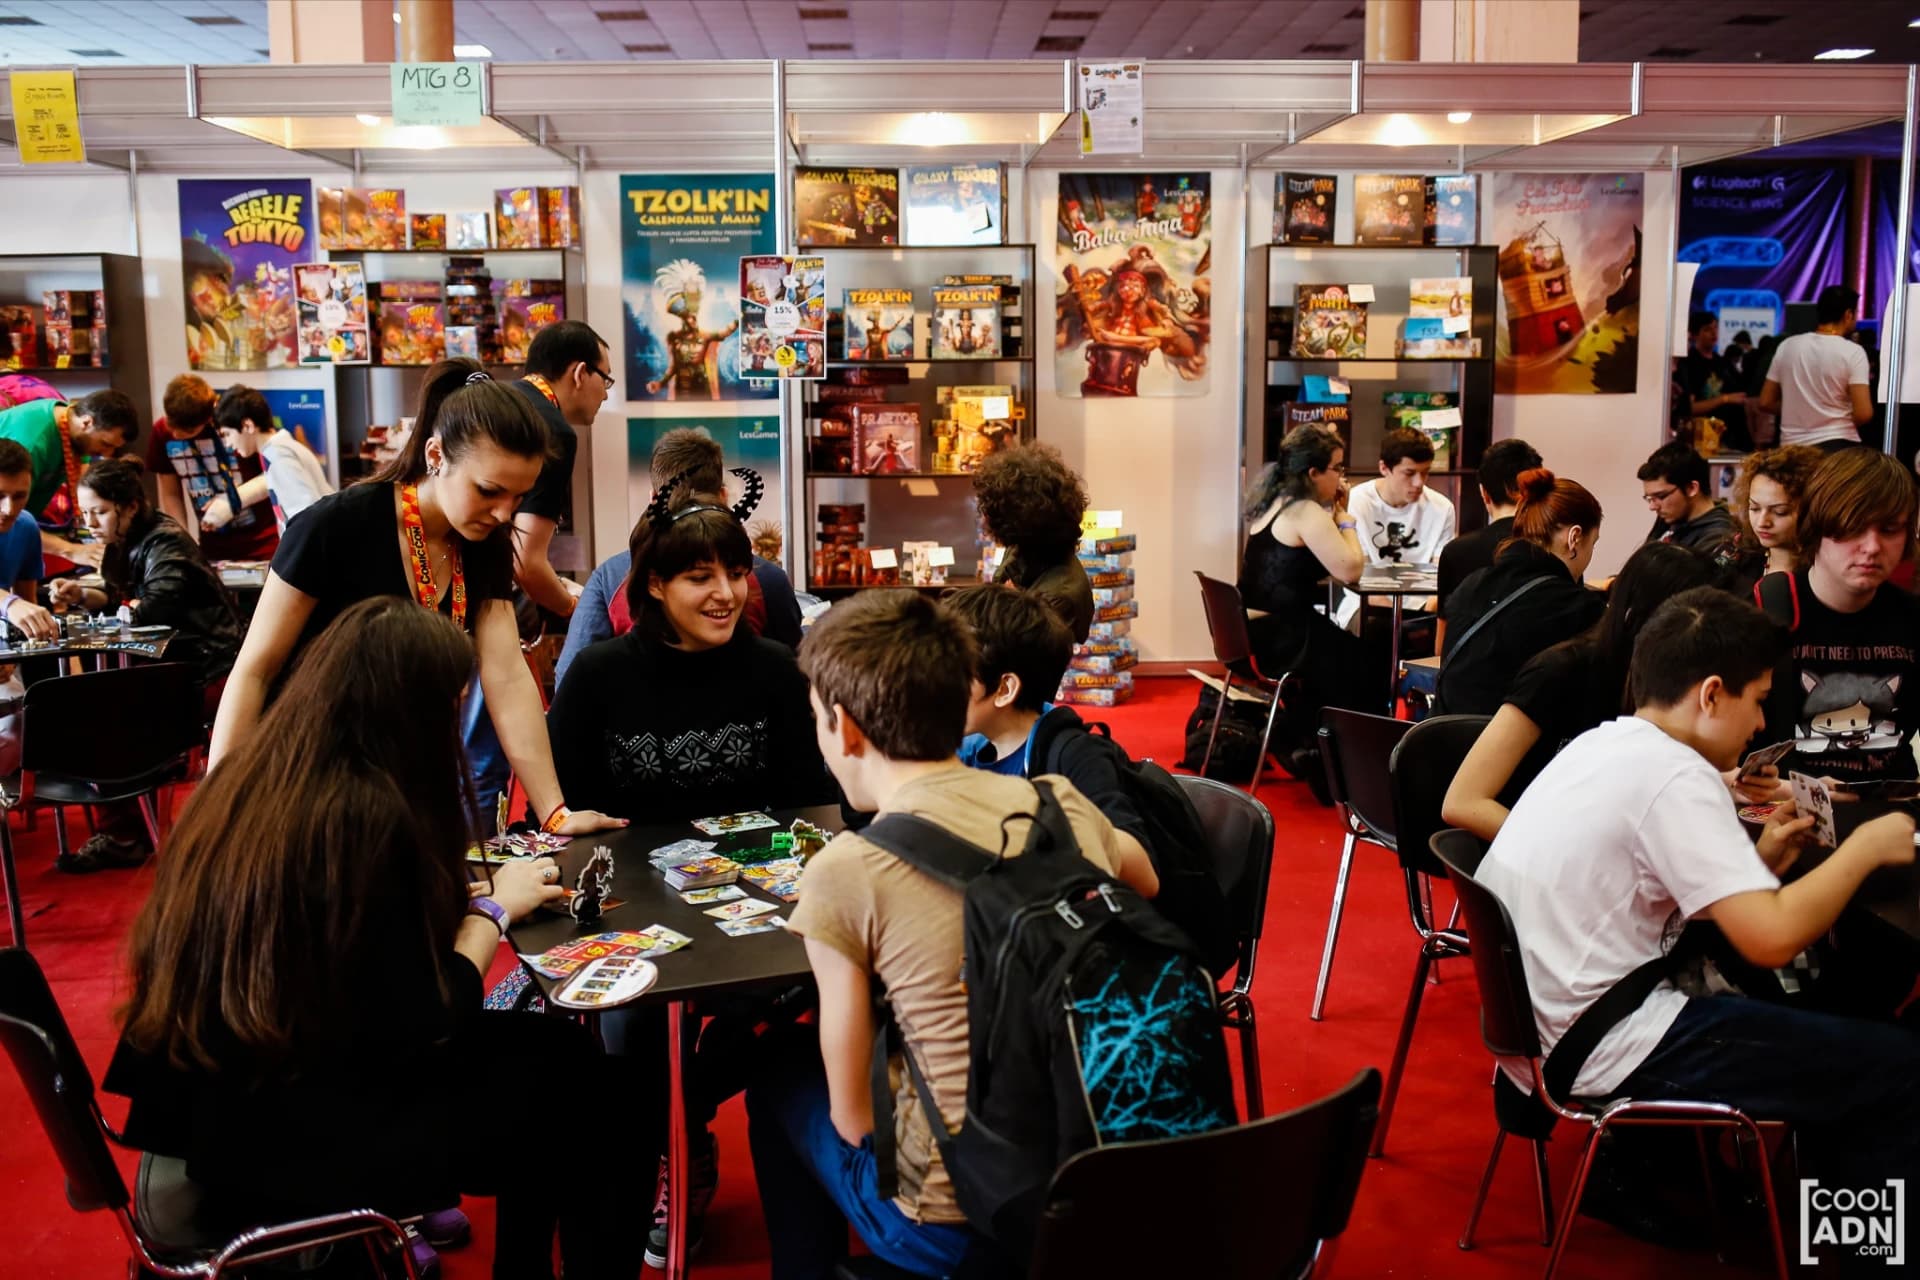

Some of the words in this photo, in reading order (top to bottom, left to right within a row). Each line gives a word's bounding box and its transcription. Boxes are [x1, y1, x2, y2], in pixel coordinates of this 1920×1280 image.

[402, 67, 446, 89] MTG
[453, 66, 471, 88] 8
[228, 193, 303, 225] REGELE
[628, 188, 770, 214] TZOLK'IN
[639, 214, 716, 226] CALENDARUL
[223, 219, 306, 253] TOKYO
[861, 411, 920, 425] PRAETOR
[412, 526, 424, 549] CON
[415, 549, 431, 585] COMIC
